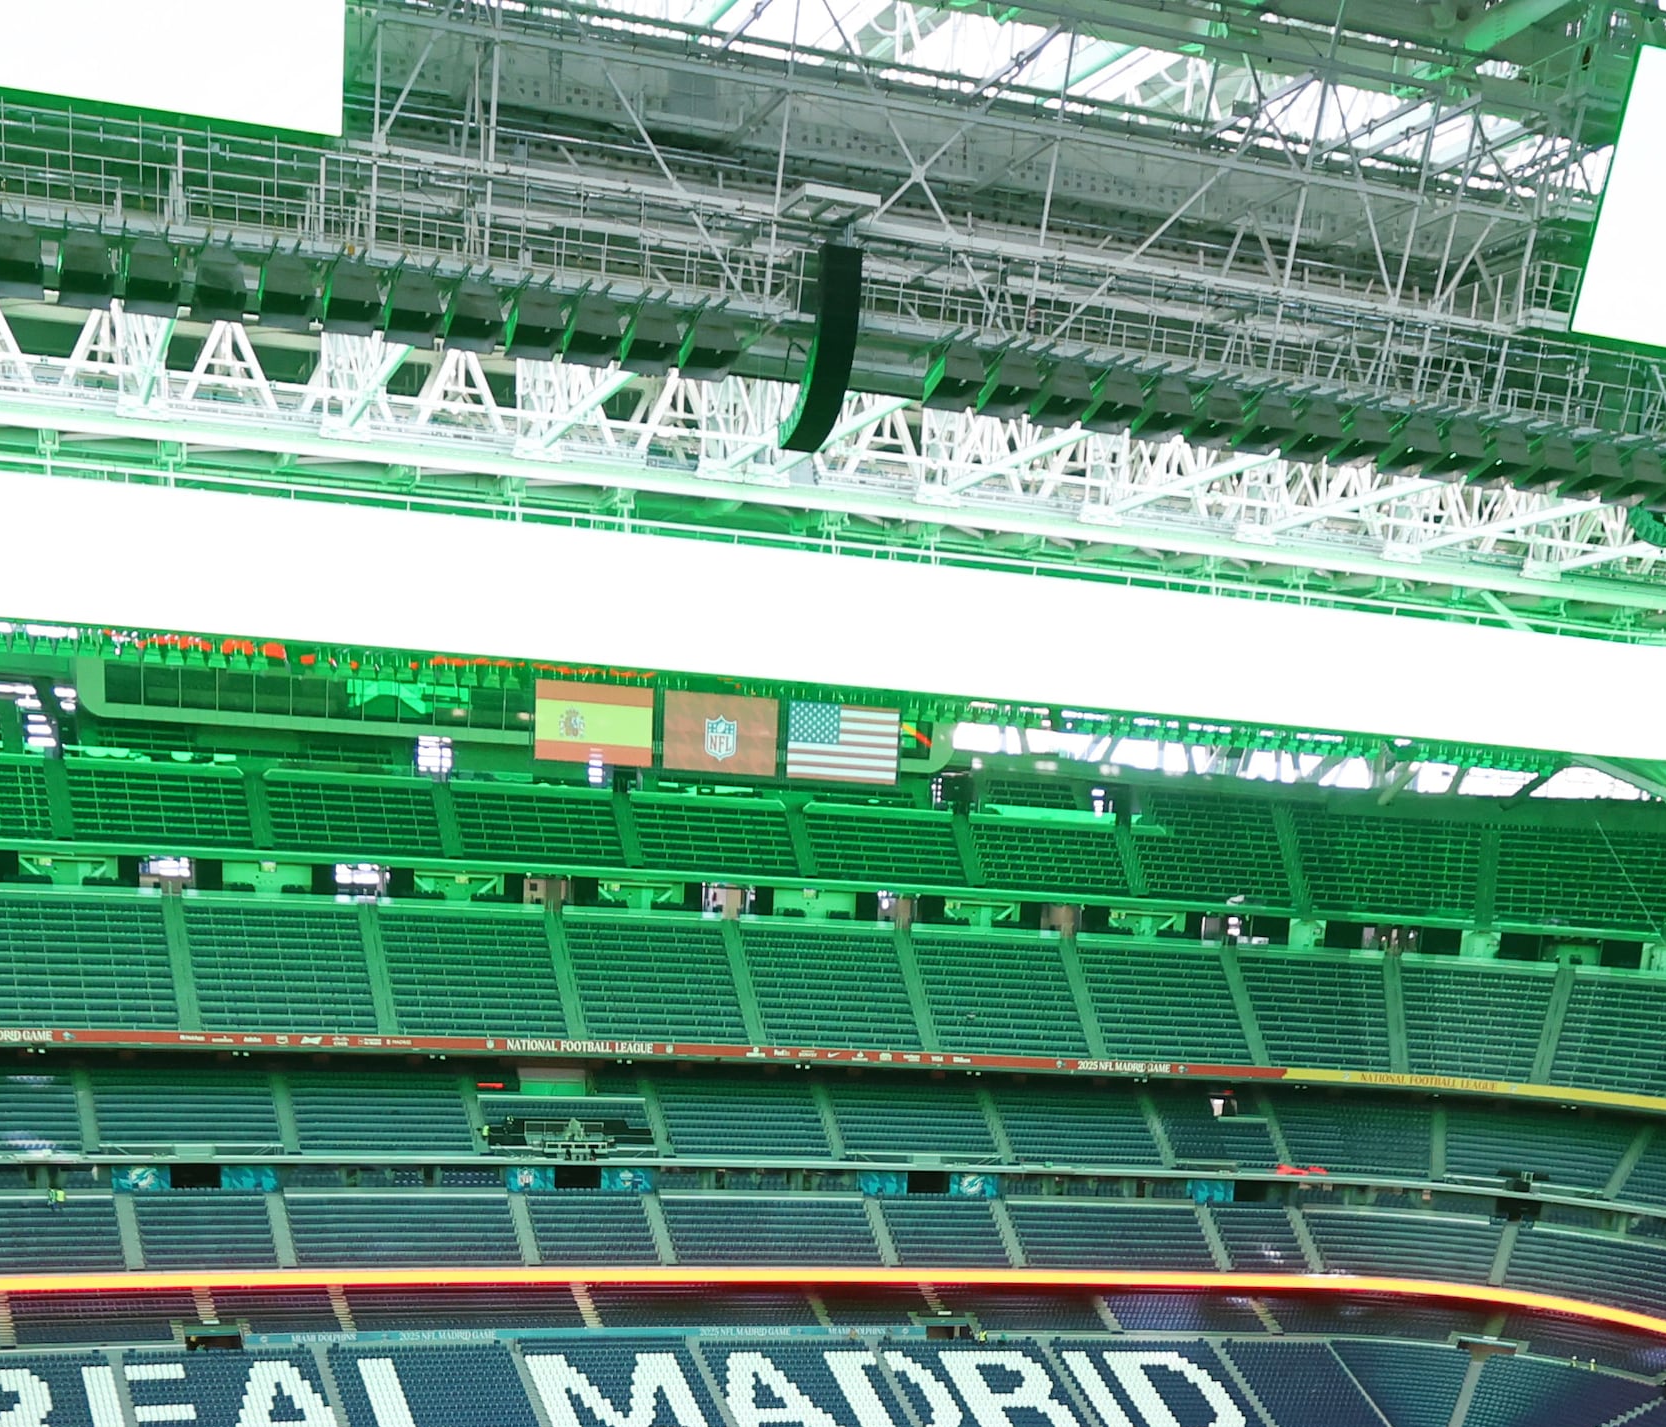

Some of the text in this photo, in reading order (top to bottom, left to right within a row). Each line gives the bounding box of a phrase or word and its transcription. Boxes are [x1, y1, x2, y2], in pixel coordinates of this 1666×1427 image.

[709, 734, 732, 754] NFL
[22, 1031, 53, 1042] GAME
[506, 1039, 654, 1054] NATIONAL FOOTBALL LEAGUE
[1077, 1060, 1171, 1073] 2025 NFL MADRID GAME
[1360, 1073, 1499, 1091] NATIONAL FOOTBALL LEAGUE
[399, 1329, 497, 1341] 2025 NFL MADRID GAME
[735, 1326, 767, 1337] MADRID
[768, 1326, 791, 1336] GAME
[291, 1333, 357, 1343] MIAMI DOLPHINS
